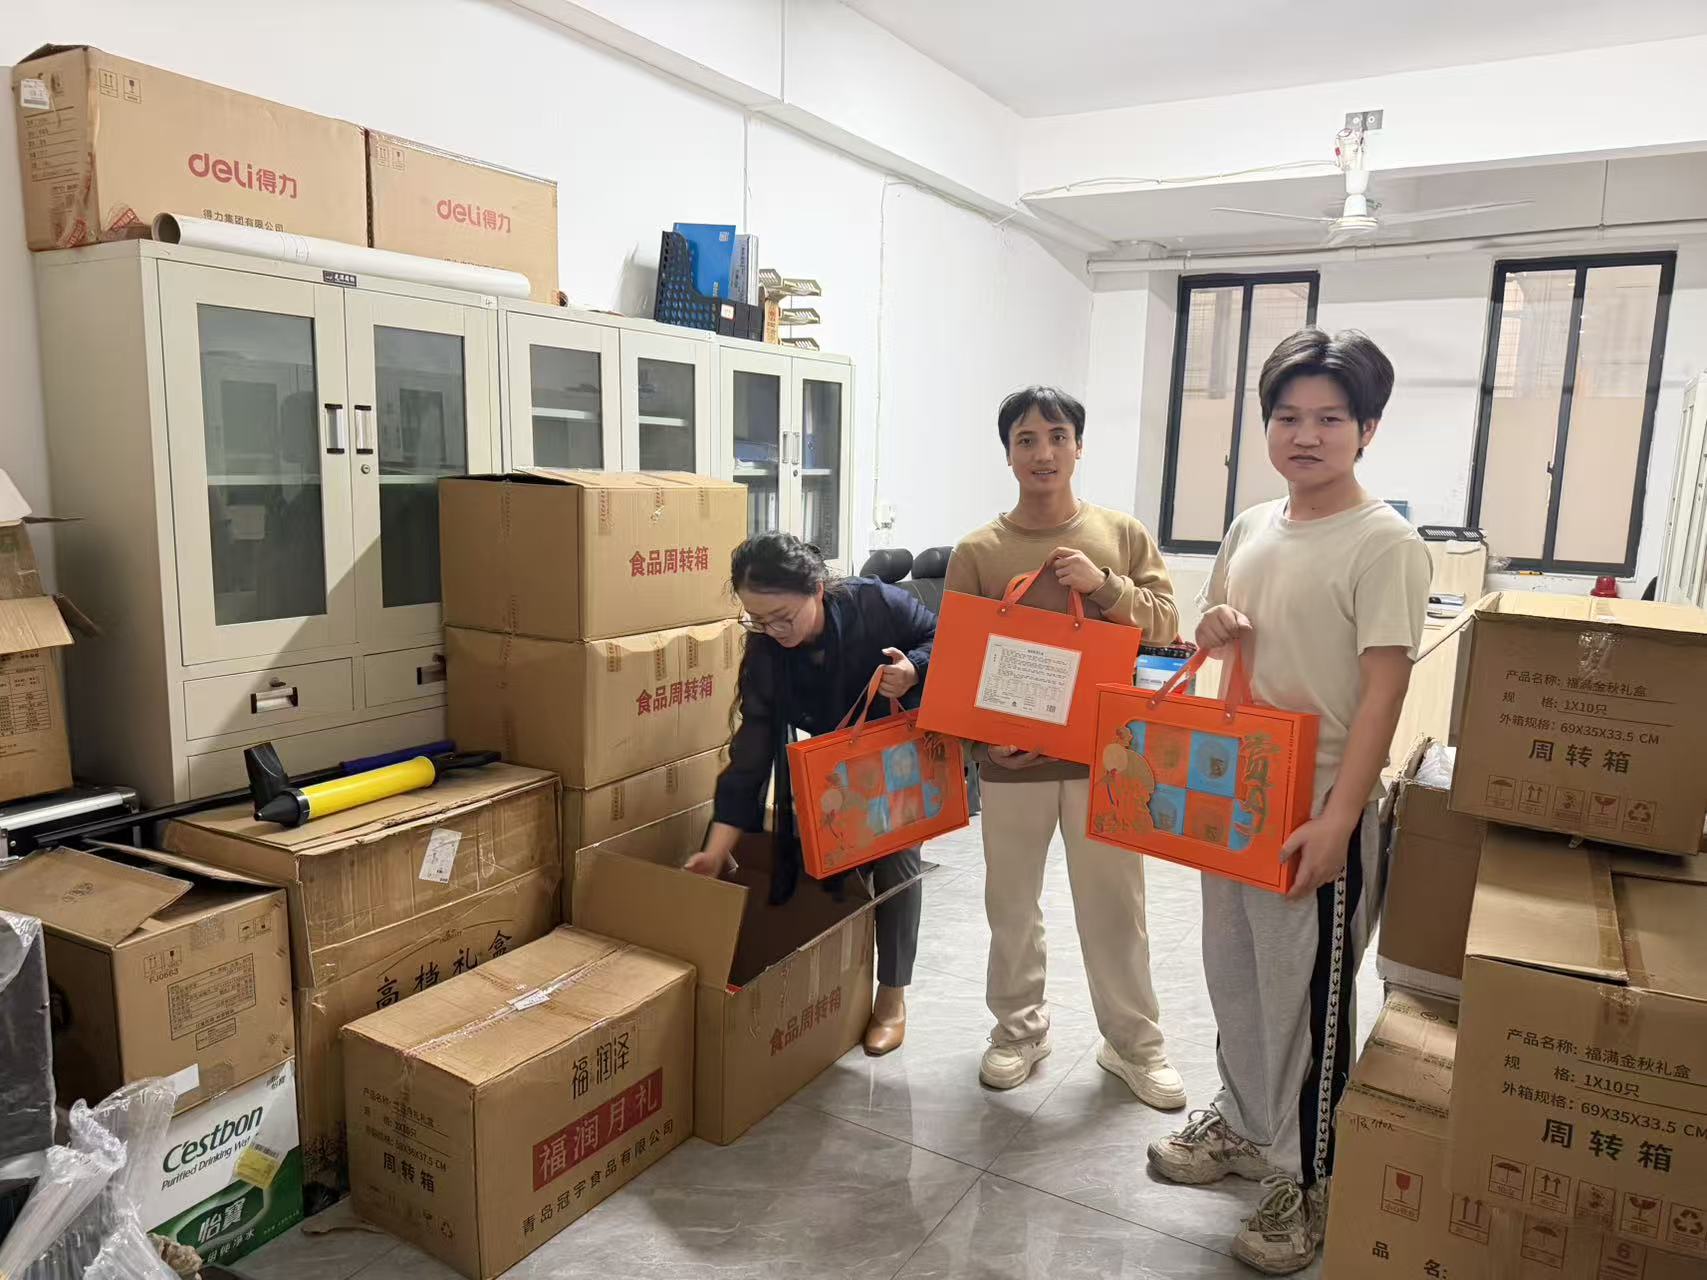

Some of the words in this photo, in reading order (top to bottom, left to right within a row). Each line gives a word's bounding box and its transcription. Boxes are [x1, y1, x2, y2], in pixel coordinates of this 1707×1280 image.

[202, 209, 284, 232] 得力集团有限公司
[629, 546, 709, 577] 食品周转箱
[636, 674, 714, 716] 食品周转箱
[1560, 722, 1634, 742] 69X35X33.5
[1639, 733, 1659, 745] CM
[376, 929, 512, 1010] 高档礼盒
[769, 985, 841, 1056] 食品周转箱
[571, 1031, 630, 1100] 福润泽
[1584, 1045, 1692, 1079] 福满金秋礼盒
[1584, 1073, 1640, 1098] 1X10只
[539, 1080, 659, 1182] 福润月礼
[1581, 1102, 1677, 1133] 69X35X33.5
[162, 1163, 198, 1191] Purified
[198, 1146, 232, 1172] Drinking
[521, 1118, 674, 1238] 青岛冠宇食品有限公司
